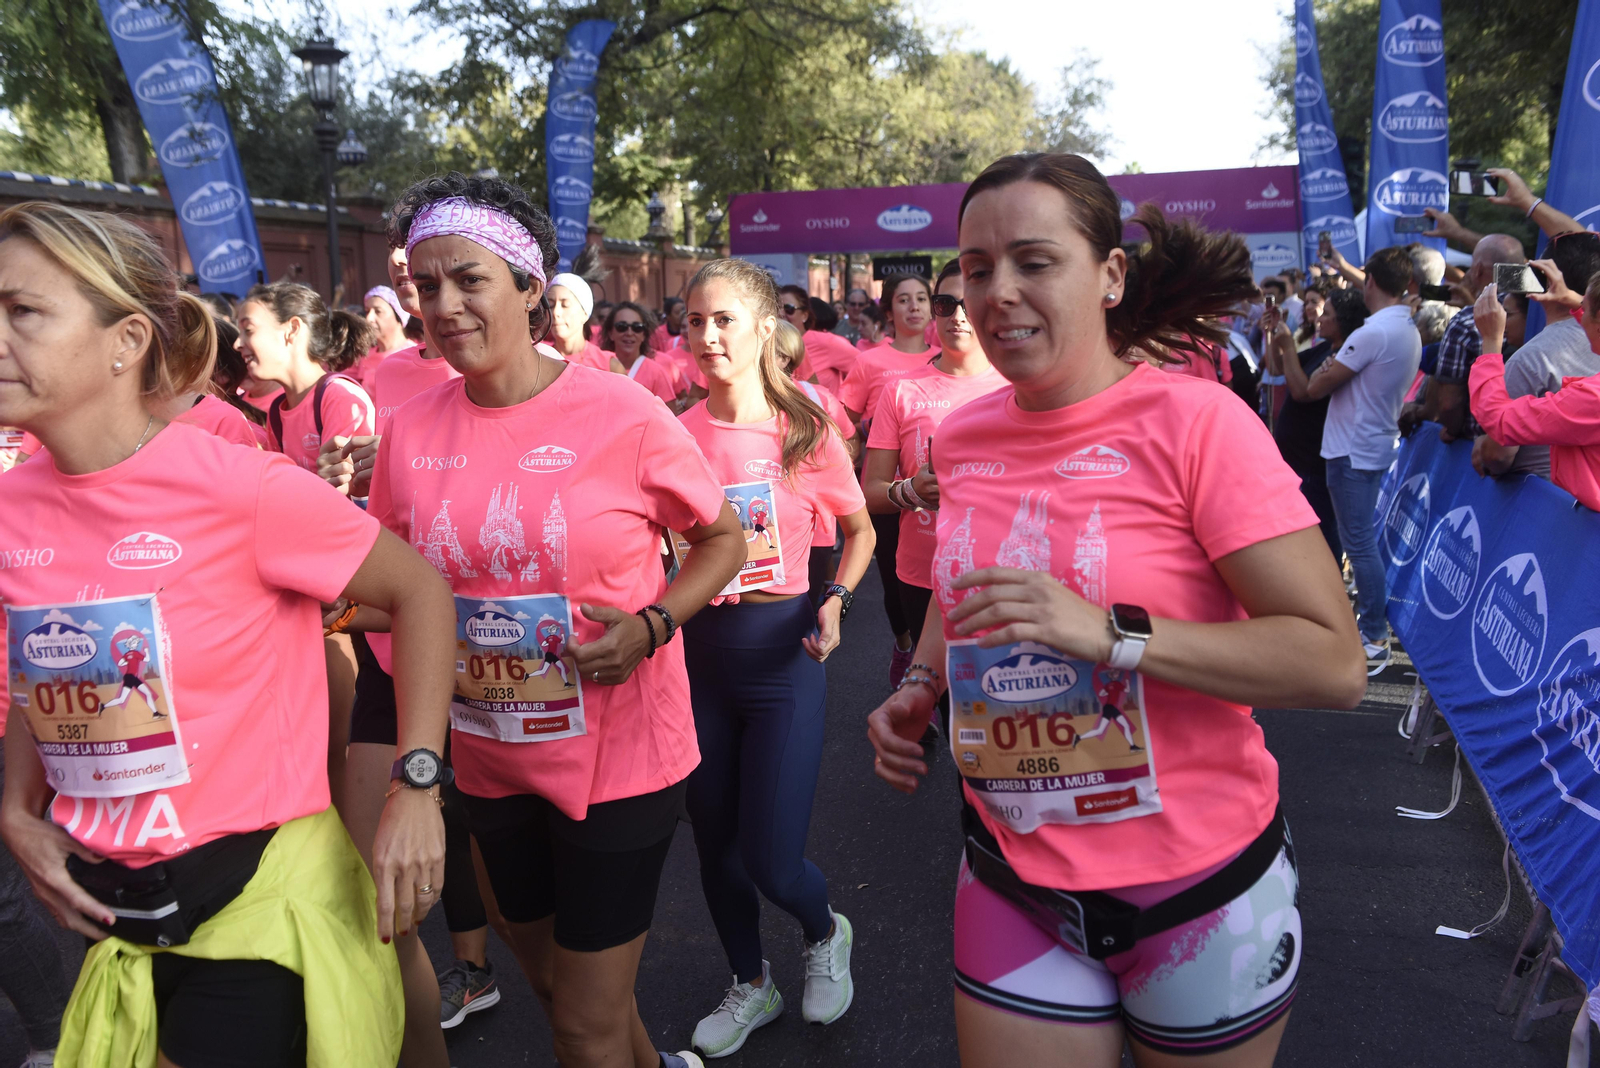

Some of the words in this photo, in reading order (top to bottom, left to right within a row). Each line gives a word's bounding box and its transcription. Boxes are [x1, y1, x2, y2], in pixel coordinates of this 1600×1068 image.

[1385, 111, 1447, 131] ASTURIAN
[1165, 199, 1216, 213] OYSHO
[1246, 198, 1294, 210] Santander
[806, 217, 850, 230] OYSHO
[882, 214, 929, 226] ASTURIANA
[740, 223, 781, 233] Santander
[881, 263, 925, 276] OYSHO
[912, 400, 950, 410] OYSHO
[411, 454, 467, 471] OYSHO
[521, 456, 572, 467] ASTURIANA
[1058, 458, 1122, 473] ASTURIANA
[748, 462, 783, 478] ASTURIAN
[111, 547, 174, 561] ASTURIANA
[741, 562, 757, 570] JER
[1424, 530, 1471, 605] ASTURIANA
[1497, 586, 1518, 615] CENTRAL
[1518, 603, 1542, 639] LECHERA
[468, 621, 521, 638] ASTURIANA
[1475, 581, 1535, 683] ASTURIANA
[27, 641, 92, 660] ASTURIANA
[469, 654, 526, 681] 016
[997, 669, 1031, 678] CENTRAL
[1032, 666, 1067, 674] LECHERA
[987, 673, 1072, 694] ASTURIANA
[34, 680, 100, 716] 016
[483, 687, 515, 700] 2038
[492, 702, 502, 711] DE
[504, 702, 515, 712] LA
[517, 702, 546, 711] MUJER
[459, 711, 491, 729] OYSHO
[535, 720, 564, 730] Santander
[57, 723, 88, 740] 5387
[991, 712, 1077, 750] 016
[68, 743, 80, 755] DE
[81, 743, 93, 755] LA
[94, 741, 129, 755] MUJER
[104, 763, 166, 781] Santander
[1016, 756, 1060, 775] 4886
[986, 779, 1027, 792] CARRERA
[1029, 778, 1044, 791] DE
[1046, 777, 1063, 790] LA
[1065, 772, 1106, 789] MUJER
[1093, 796, 1130, 809] Santander
